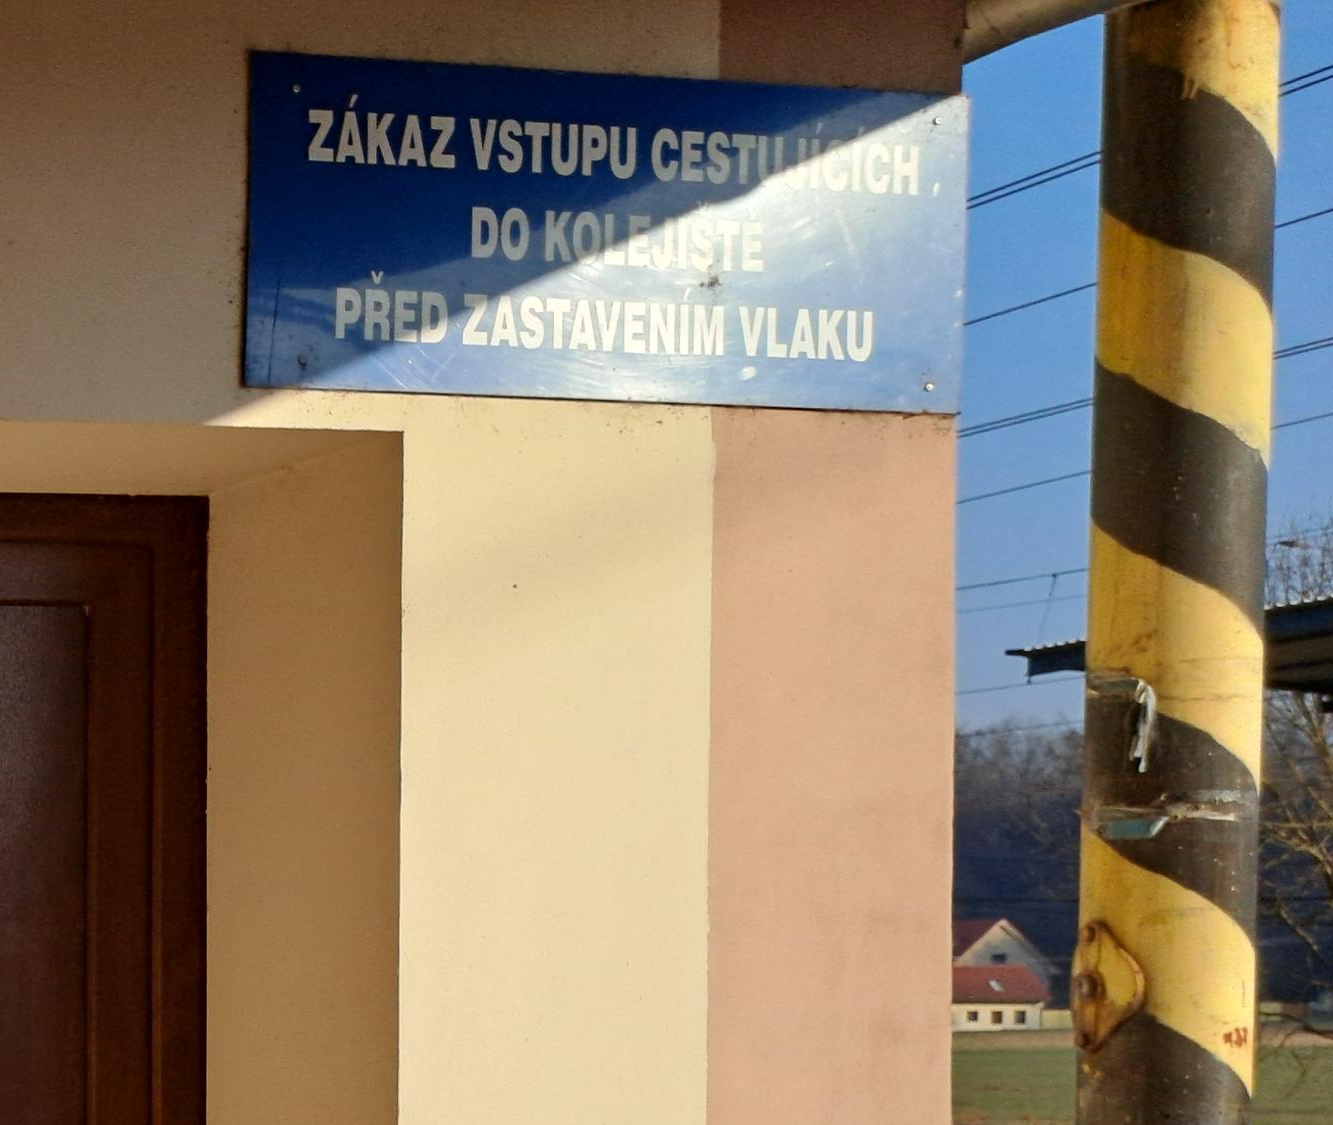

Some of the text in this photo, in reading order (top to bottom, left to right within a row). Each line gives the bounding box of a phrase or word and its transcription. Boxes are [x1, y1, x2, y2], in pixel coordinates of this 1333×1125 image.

[308, 94, 920, 197] ZÁKAZ VSTUPU CESTUJÍCÍCH
[471, 206, 531, 262] DO
[335, 270, 449, 345] PŘED
[739, 305, 874, 363] VLAKU
